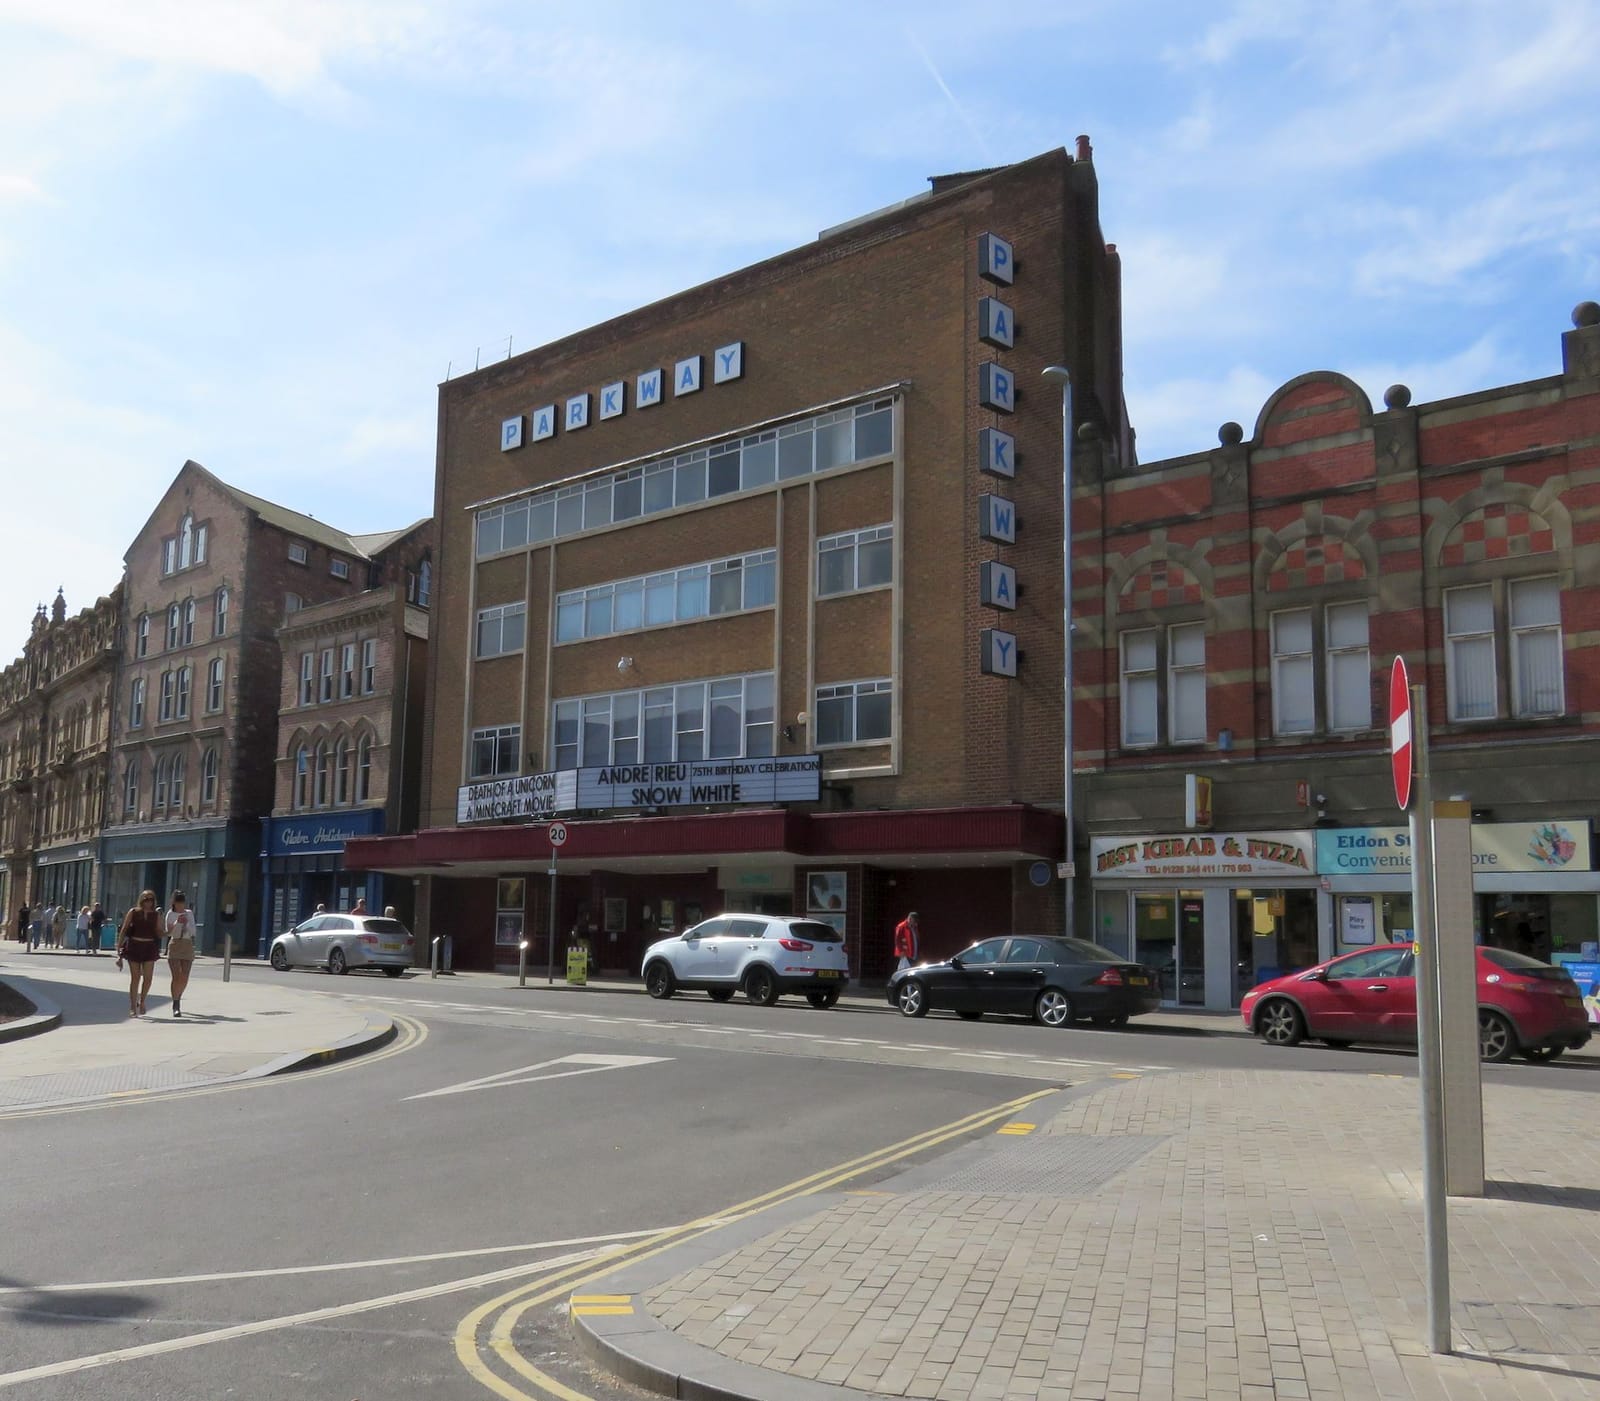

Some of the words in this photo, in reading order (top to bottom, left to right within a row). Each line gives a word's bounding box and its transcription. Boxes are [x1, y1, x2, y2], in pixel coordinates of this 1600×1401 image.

[504, 349, 737, 446] PARKWAY
[598, 766, 649, 785] ANDRE
[655, 764, 686, 782] RIEU
[692, 766, 712, 777] 75TH
[715, 764, 755, 776] BIRTHDAY
[758, 761, 819, 774] CELEBRATION
[468, 783, 492, 801] DEATH
[494, 781, 505, 798] OF
[507, 779, 513, 796] A
[515, 774, 555, 795] UNICORN
[631, 786, 682, 805] SNOW
[691, 784, 741, 802] WHITE
[466, 806, 472, 820] A
[474, 800, 521, 818] MINECRAFT
[523, 795, 553, 814] MOVIE
[281, 827, 310, 846] Globe
[551, 828, 565, 841] 20
[1336, 835, 1389, 849] Eldon
[1096, 842, 1139, 873] BEST
[1142, 837, 1217, 861] KEBAB
[1222, 837, 1244, 858] &
[1246, 838, 1310, 871] PIZZA
[1336, 851, 1412, 868] Convenie
[1472, 852, 1498, 866] ore
